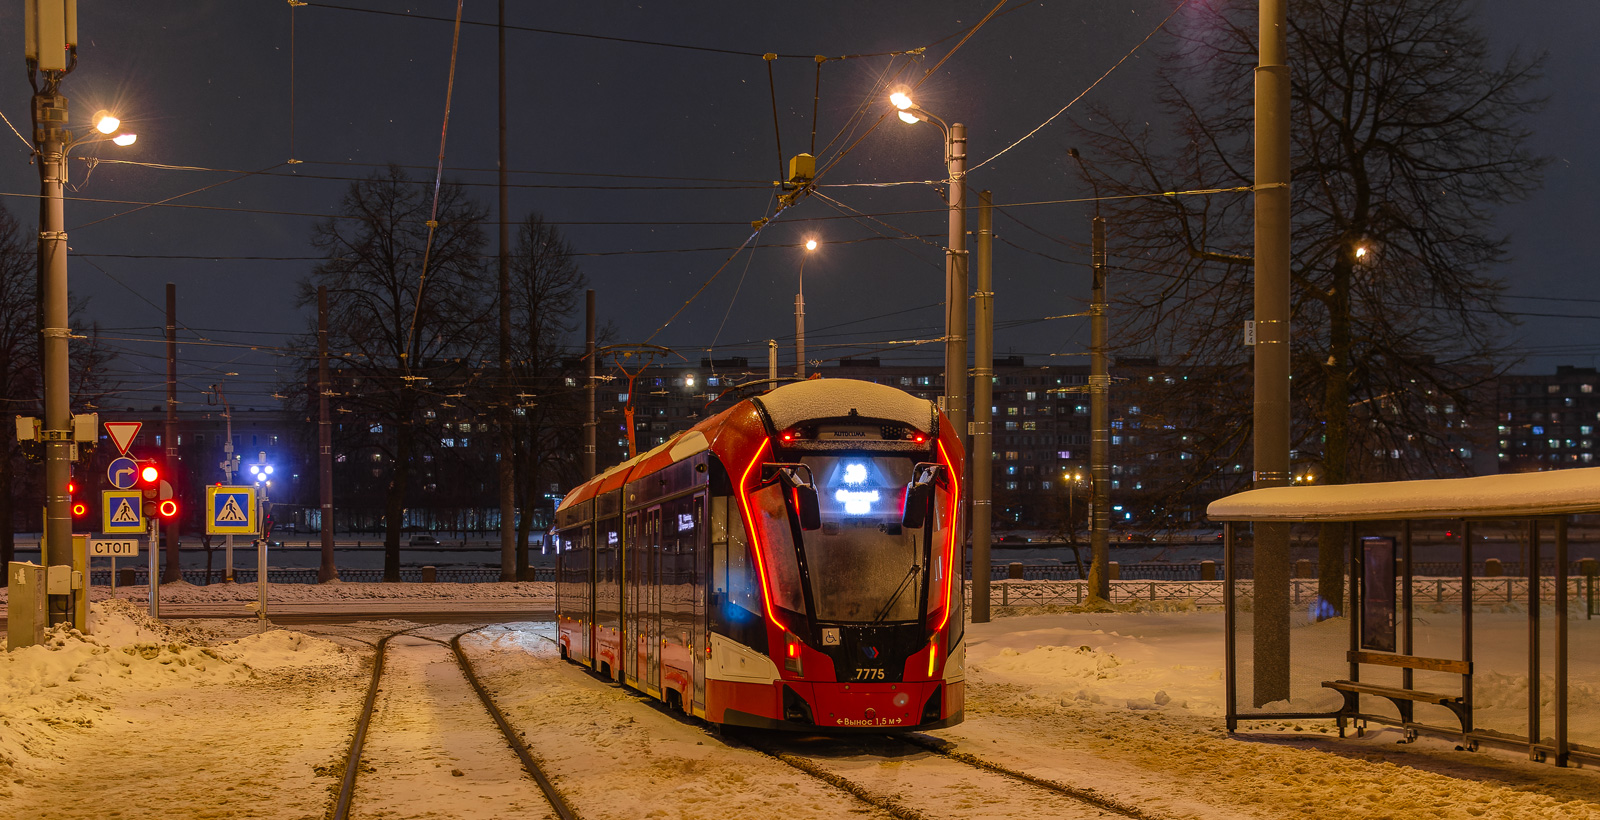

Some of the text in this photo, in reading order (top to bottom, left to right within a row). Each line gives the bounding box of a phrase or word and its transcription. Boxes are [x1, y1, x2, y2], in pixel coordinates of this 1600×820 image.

[95, 542, 131, 554] СТОП
[856, 668, 885, 680] 7775
[844, 717, 873, 726] Вынос
[875, 717, 887, 727] 1,5
